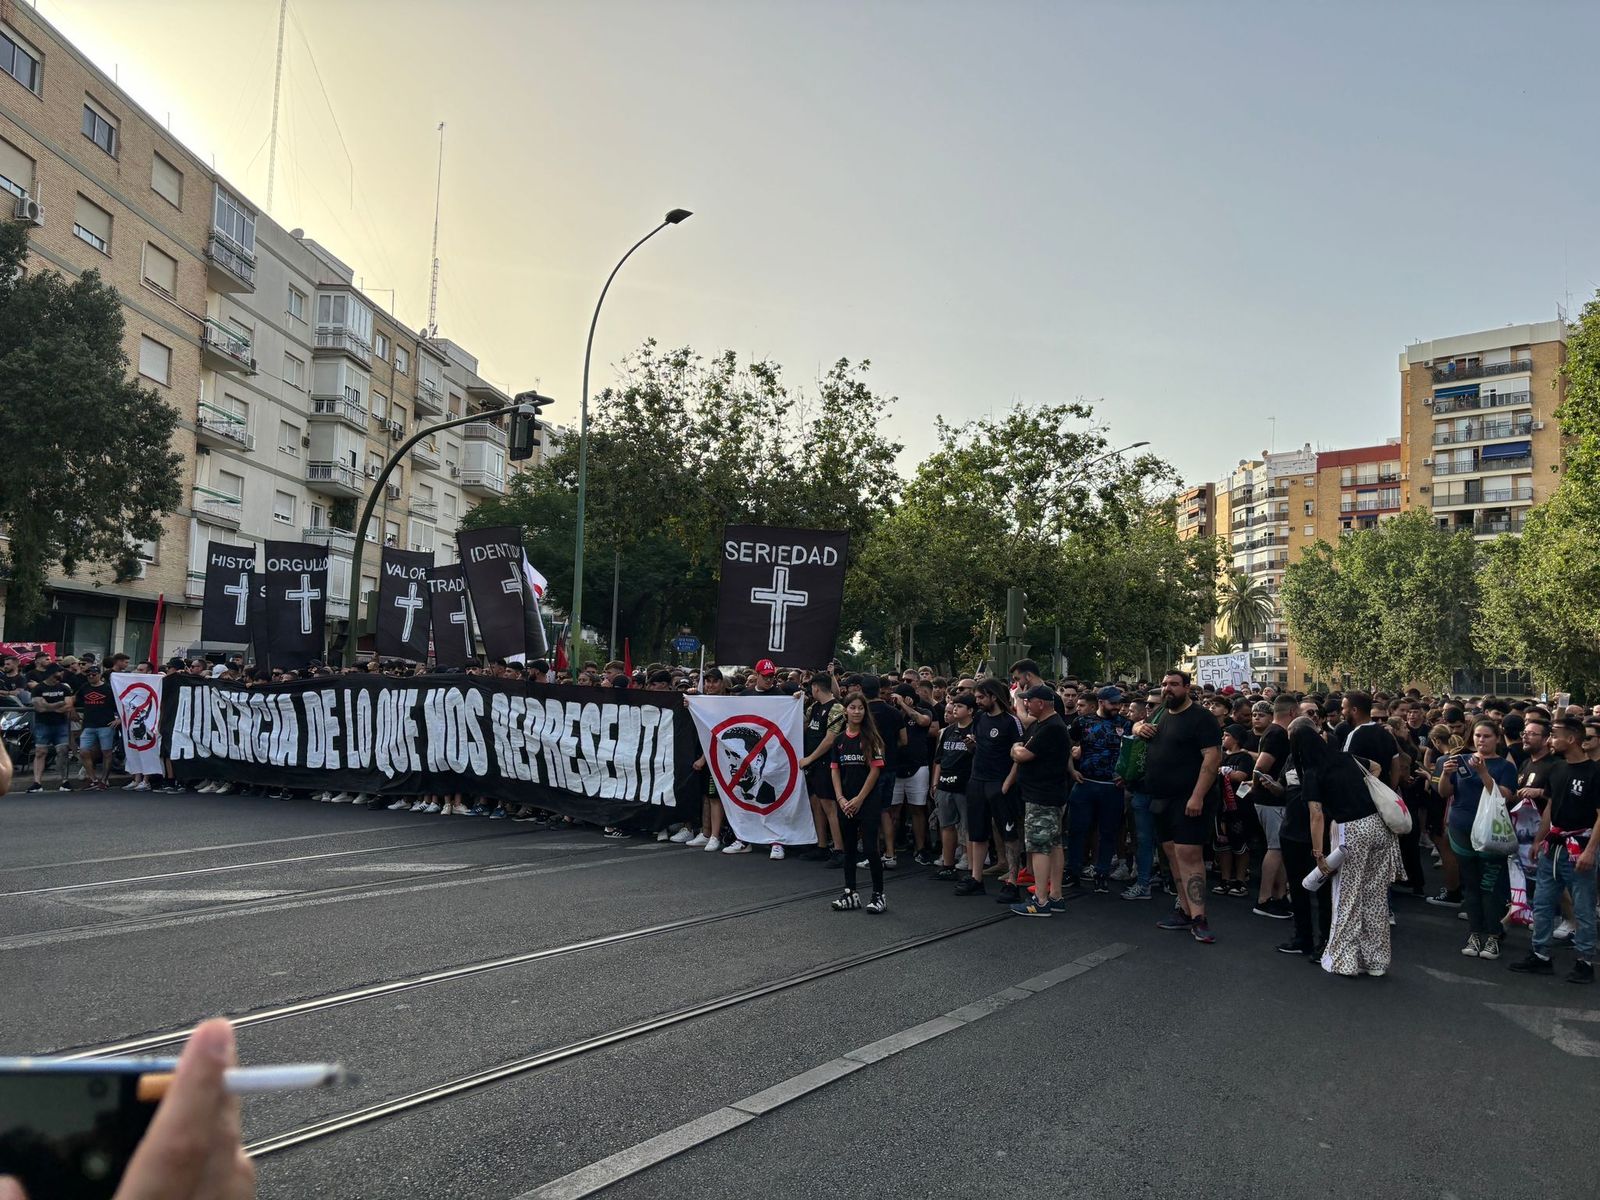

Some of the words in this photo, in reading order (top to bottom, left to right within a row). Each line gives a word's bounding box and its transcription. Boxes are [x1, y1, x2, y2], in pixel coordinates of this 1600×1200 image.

[211, 553, 256, 570] HISTO
[725, 541, 838, 566] SERIEDAD
[267, 557, 329, 572] ORGULLO
[385, 562, 427, 580] VALOR
[170, 685, 298, 766] AUSENCIA
[302, 689, 341, 769] DE
[344, 688, 372, 768] LO
[375, 688, 422, 779] QUE
[424, 687, 488, 776] NOS
[491, 692, 677, 807] REPRESENTA
